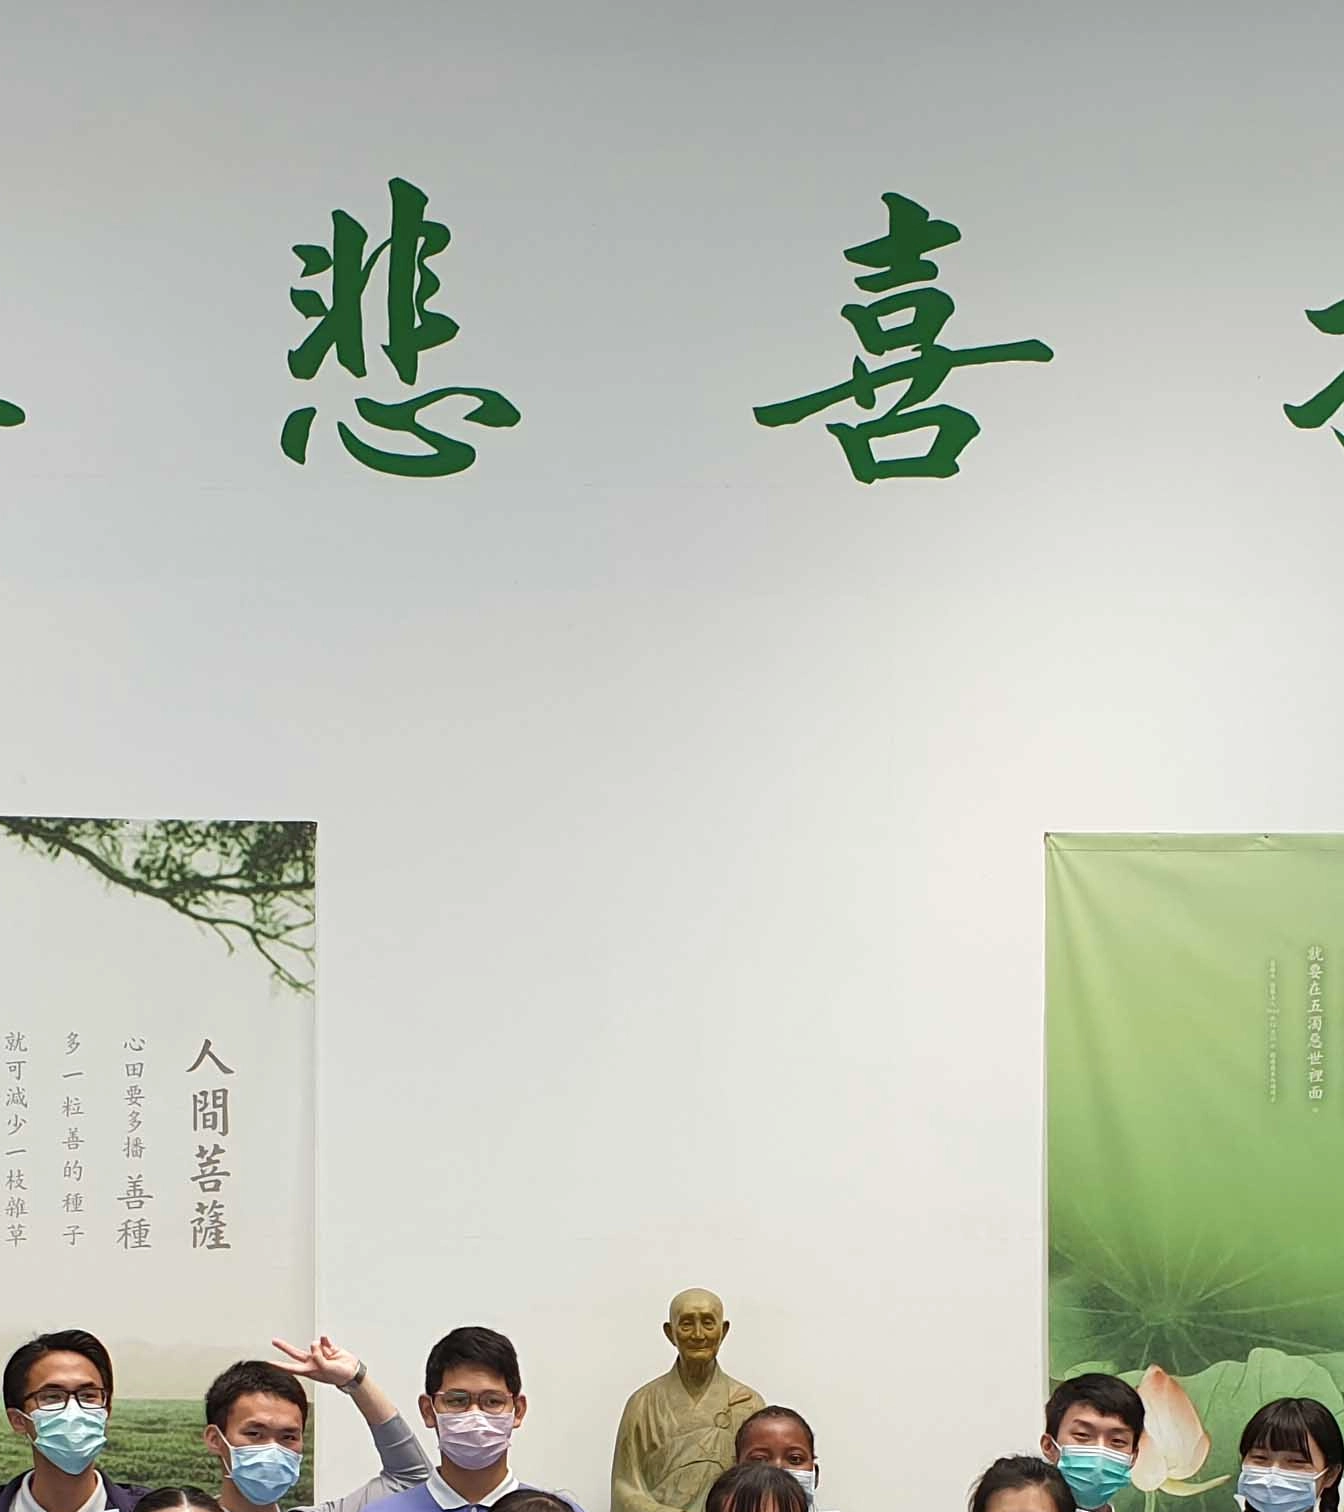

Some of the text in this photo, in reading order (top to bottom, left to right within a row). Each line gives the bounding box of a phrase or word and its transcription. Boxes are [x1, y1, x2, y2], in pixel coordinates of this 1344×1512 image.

[5, 1031, 29, 1247] 就可減少一枝雜草
[61, 1031, 85, 1247] 多一粒善的種子
[116, 1036, 154, 1250] 心田要多播善種
[186, 1038, 234, 1250] 人間菩薩
